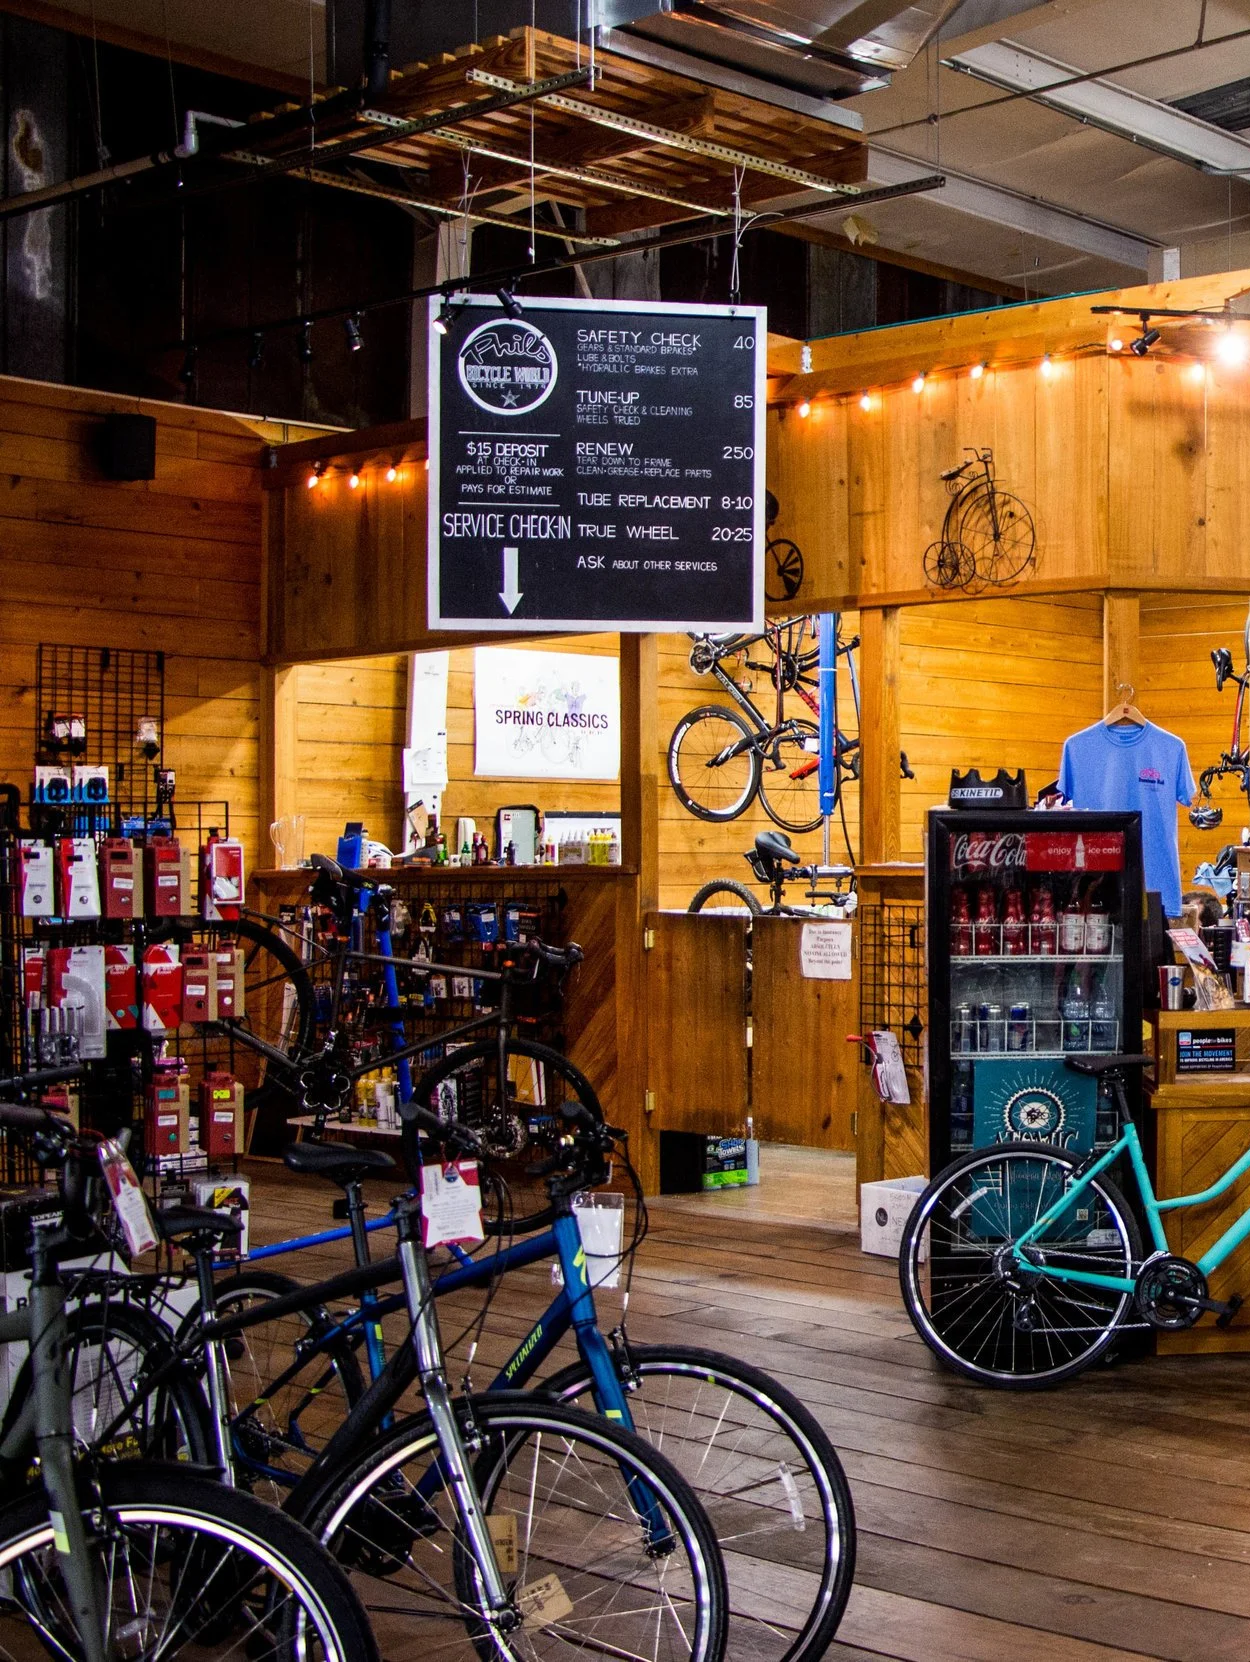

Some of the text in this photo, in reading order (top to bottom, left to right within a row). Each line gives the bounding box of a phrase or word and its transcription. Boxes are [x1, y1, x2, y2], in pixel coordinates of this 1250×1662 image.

[577, 329, 755, 350] SAFETY CHECK 40
[577, 343, 605, 352] GEARS
[607, 345, 613, 353] &
[614, 345, 657, 355] STANDARD
[577, 353, 636, 364] LUBE & BOLTS
[466, 364, 550, 384] BICYCLE WORLD
[634, 365, 667, 375] BRAKES
[671, 366, 699, 376] EXTRA
[577, 390, 754, 409] TUNE-UP 85
[576, 404, 693, 417] SAFETY CHECK & CLEANING
[576, 415, 641, 426] WHEELS TRUED
[467, 441, 550, 457] $15 DEPOSIT
[576, 442, 754, 459] RENEW 250
[477, 456, 537, 467] AT CHECK-IN
[577, 456, 672, 467] TEAR DOWN TO FRAME
[456, 464, 564, 477] APPLIED TO REPAIR WORK
[685, 469, 712, 478] PARTS
[504, 475, 517, 485] OR
[461, 484, 552, 496] PAYS FOR ESTIMATE
[577, 492, 754, 510] TUBE REPLACEMENT 8-10
[443, 512, 571, 539] SERVICE CHECK-IN
[577, 524, 754, 541] TRUE WHEEL 20-25
[577, 555, 718, 572] ASK ABOUT OTHER SERVICES
[715, 671, 744, 704] RALEIGH
[495, 709, 609, 729] SPRING CLASSICS
[960, 787, 1002, 797] KINETIC
[1047, 846, 1121, 856] enjoy ice cold
